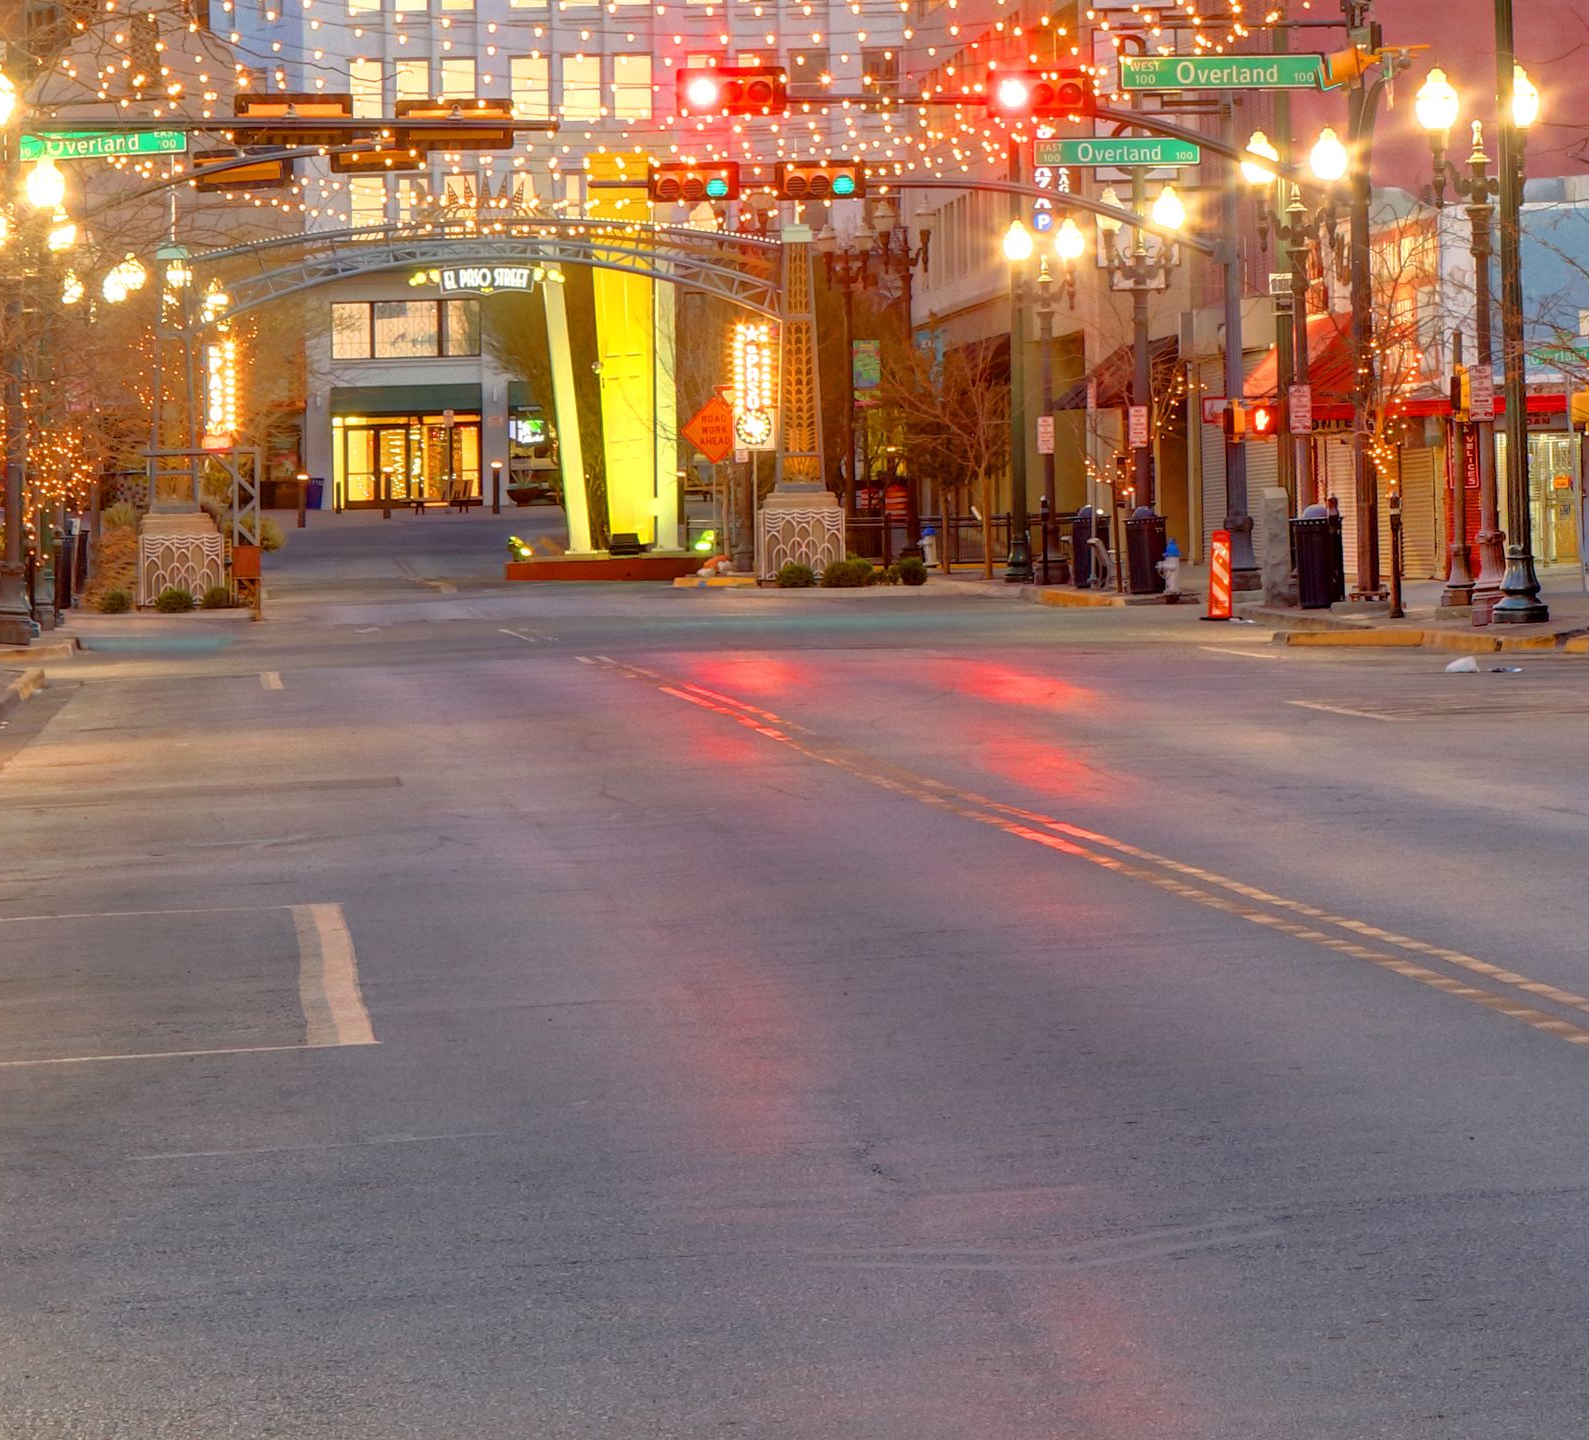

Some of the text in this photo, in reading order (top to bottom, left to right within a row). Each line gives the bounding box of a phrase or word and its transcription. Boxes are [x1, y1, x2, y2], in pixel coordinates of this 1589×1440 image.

[1129, 61, 1279, 84] WEST Overland
[1134, 72, 1315, 85] 100 100
[46, 134, 139, 156] Overland
[1040, 143, 1162, 162] EAST Overland
[1043, 151, 1193, 163] 100 100
[443, 268, 530, 289] EL PASO STREET
[701, 414, 727, 424] ROAD
[701, 424, 728, 434] WORK
[699, 435, 731, 446] AHEAD
